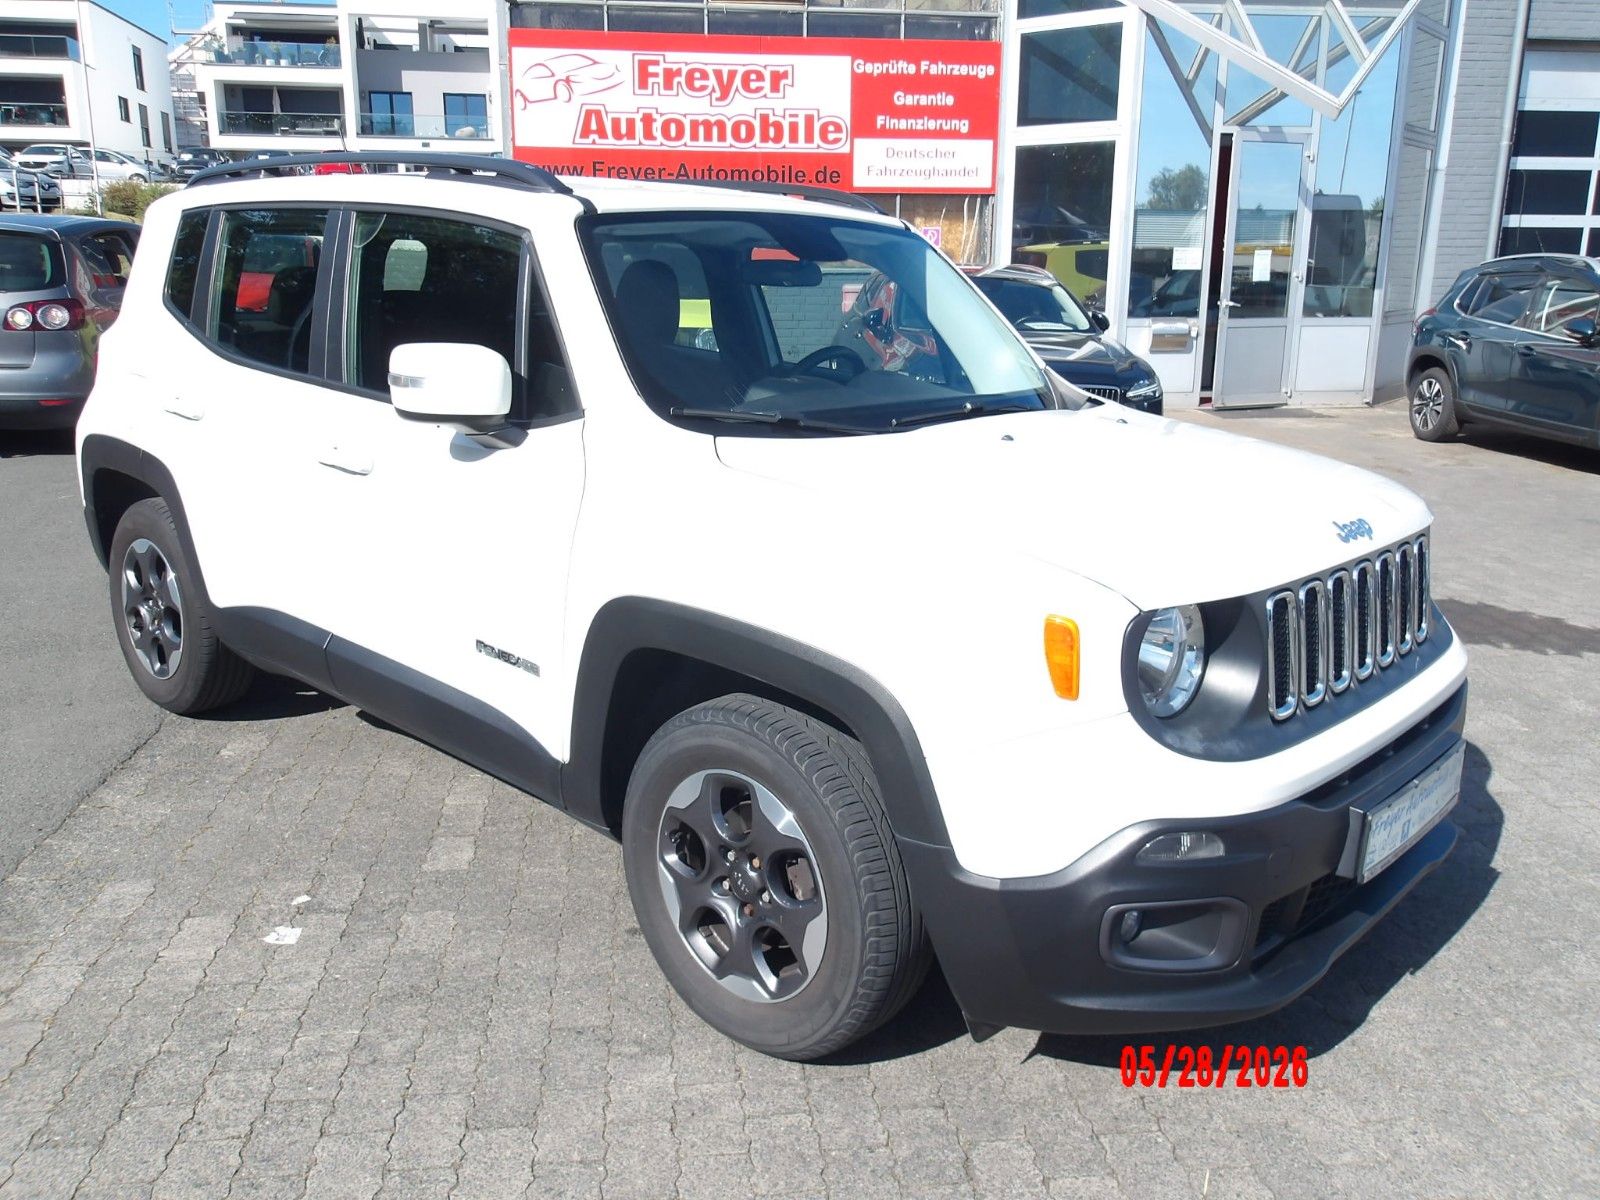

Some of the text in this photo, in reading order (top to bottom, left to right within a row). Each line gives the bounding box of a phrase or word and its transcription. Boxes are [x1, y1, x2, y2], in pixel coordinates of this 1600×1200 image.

[853, 59, 995, 79] Geprüfte Fahrzeuge
[635, 55, 791, 104] Freyer
[893, 91, 955, 106] Garantie
[576, 105, 846, 148] Automobile
[876, 115, 969, 133] Finanzierung
[885, 147, 957, 159] Deutscher
[535, 161, 841, 183] wwFreyer-Automobile.de
[867, 165, 979, 180] Fahrzeughandel
[1332, 518, 1373, 544] Jeep
